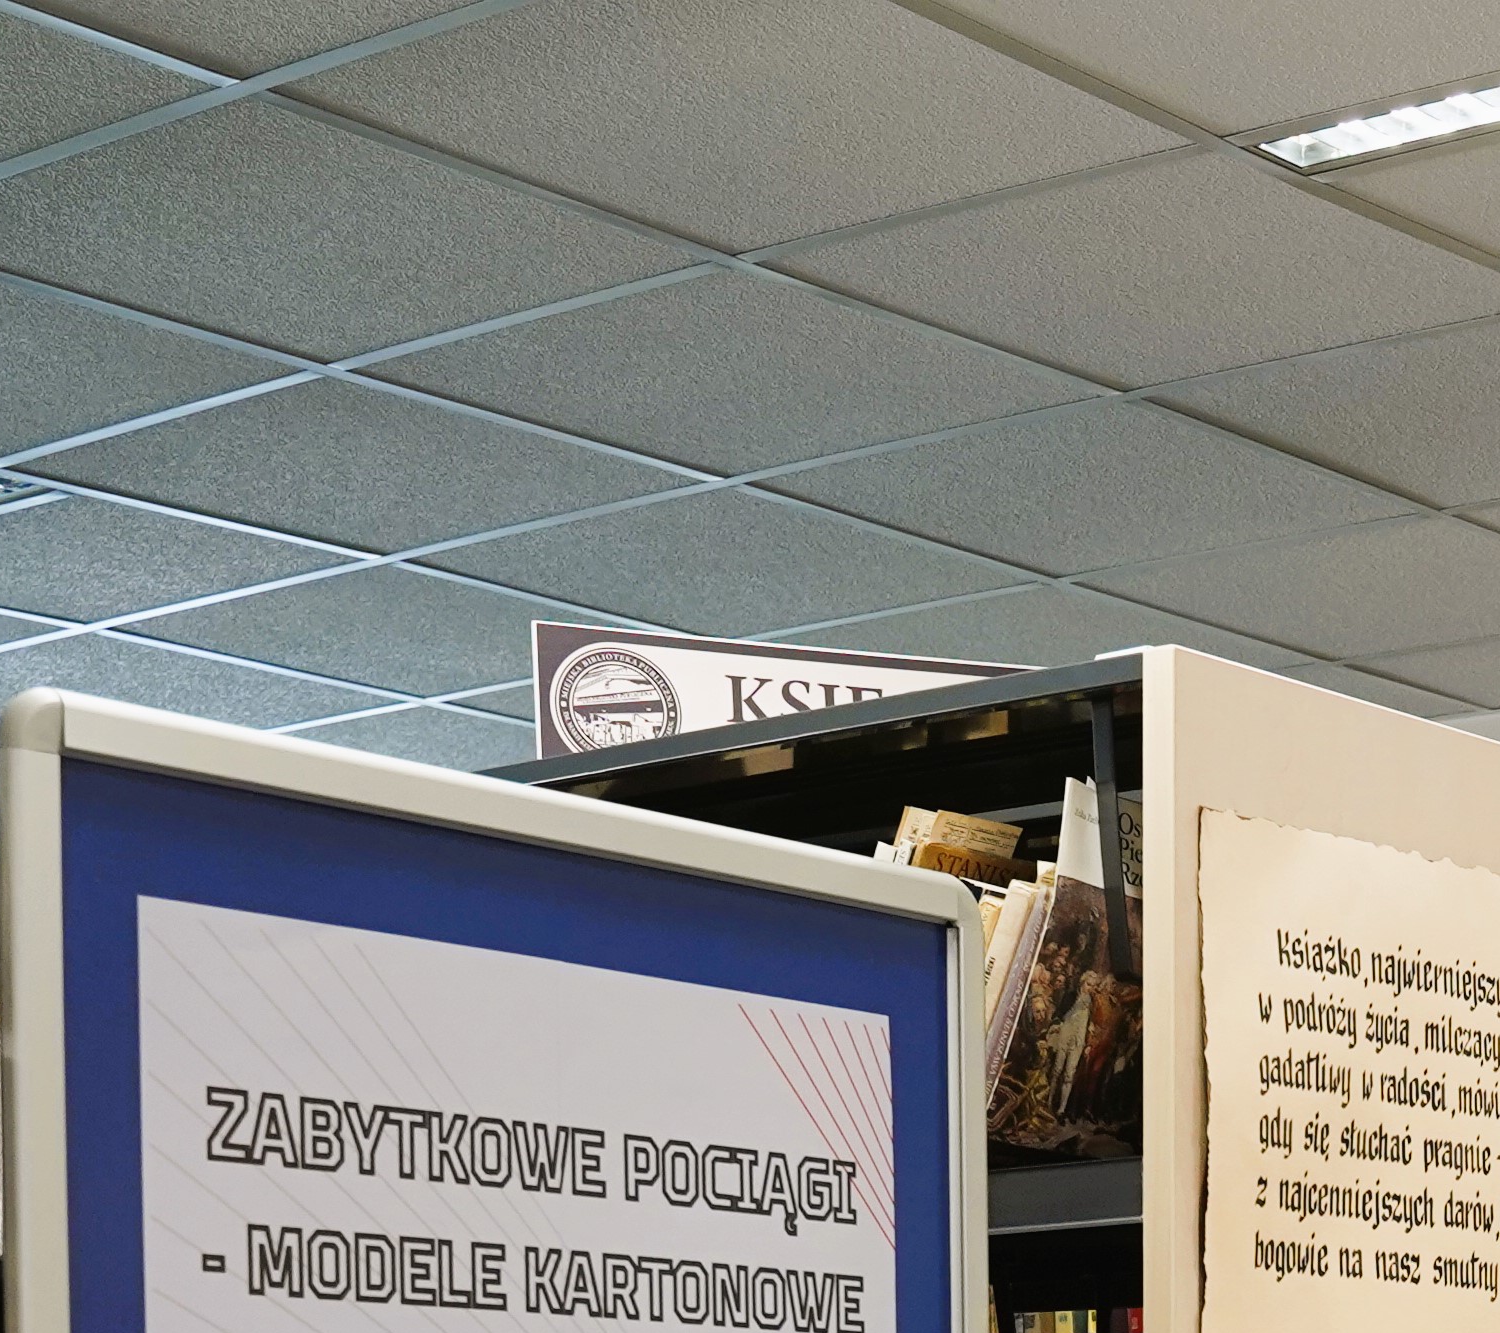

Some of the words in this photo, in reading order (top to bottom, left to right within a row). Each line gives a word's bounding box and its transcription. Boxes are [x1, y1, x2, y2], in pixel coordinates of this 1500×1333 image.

[1258, 993, 1272, 1024] w
[1284, 993, 1357, 1048] podróży
[1424, 1016, 1500, 1072] milczący
[1260, 1049, 1351, 1108] gadatliwy
[1362, 1071, 1374, 1101] w
[207, 1086, 606, 1198] ZABYTKOWE
[624, 1134, 855, 1235] POCIĄGI
[1260, 1107, 1293, 1158] gdy
[1304, 1112, 1330, 1162] się
[1340, 1123, 1412, 1165] słuchać
[1423, 1135, 1491, 1178] pragnie
[1257, 1175, 1267, 1207] z
[1279, 1172, 1435, 1230] najcenniejszych
[202, 1254, 225, 1273] -
[248, 1224, 507, 1310] MODELE
[1255, 1231, 1328, 1282] bogowie
[1339, 1247, 1363, 1278] na
[1375, 1249, 1421, 1284] nasz
[1433, 1254, 1498, 1302] smutny
